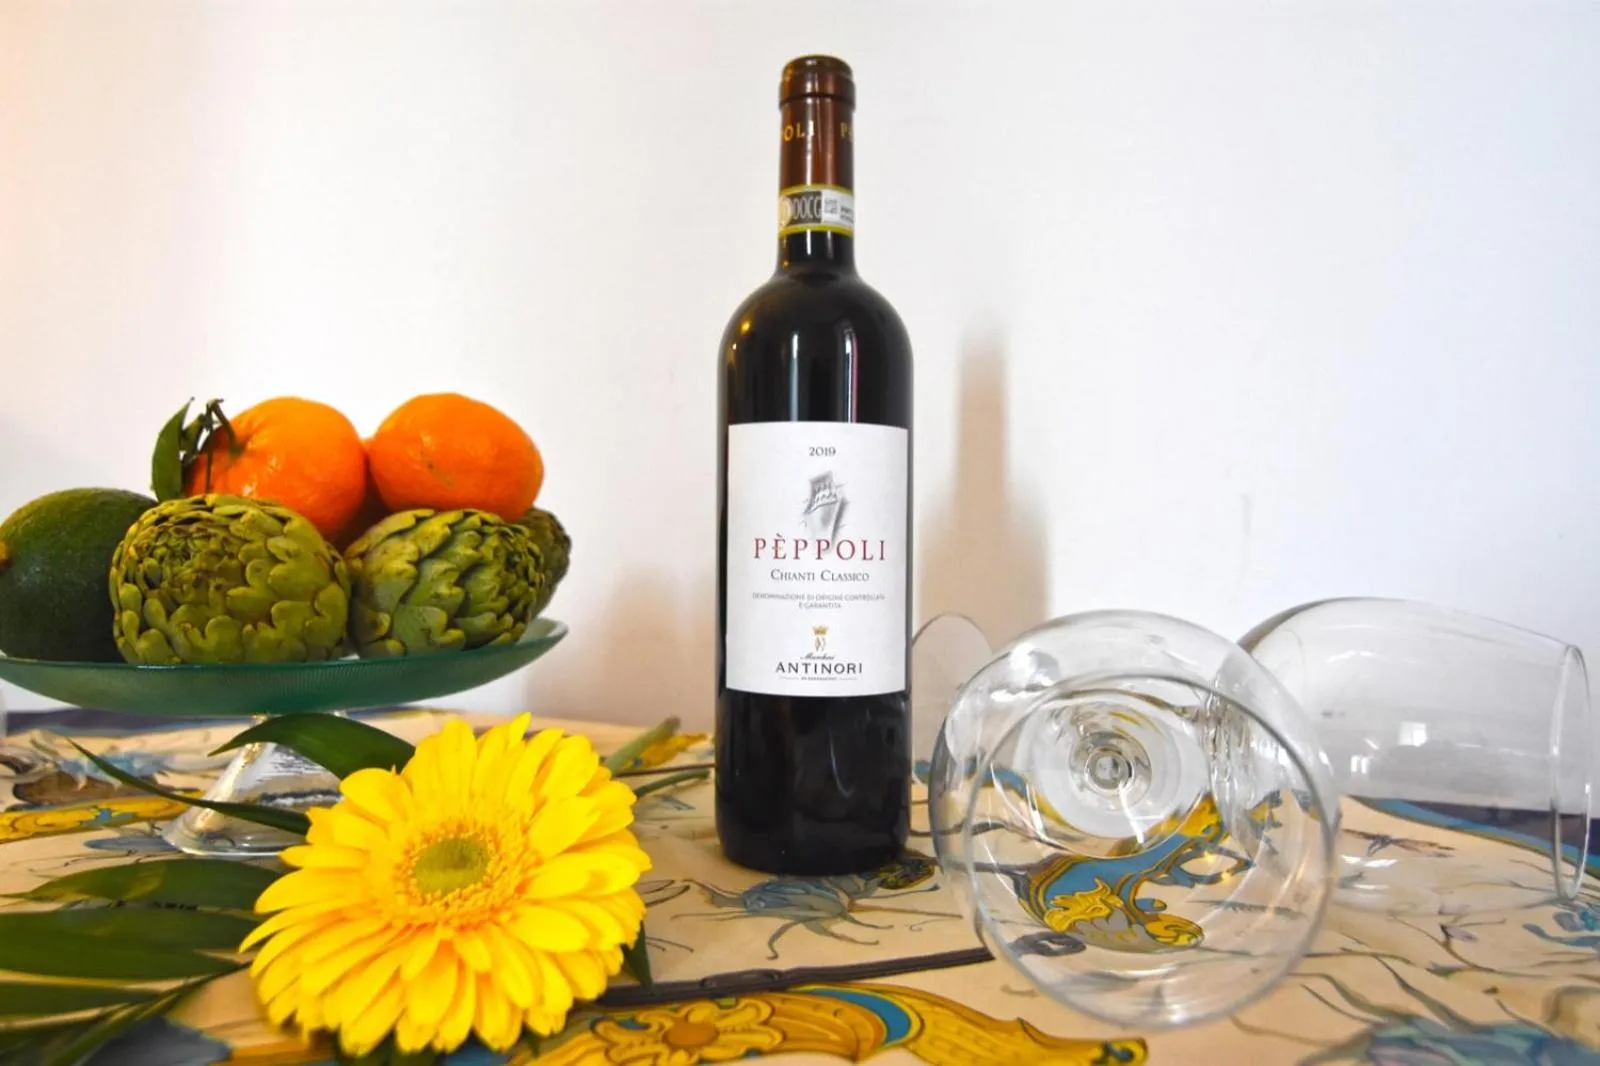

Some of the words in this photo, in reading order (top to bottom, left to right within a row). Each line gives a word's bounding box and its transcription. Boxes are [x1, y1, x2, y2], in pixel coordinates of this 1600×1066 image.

[808, 446, 837, 457] 2019
[753, 533, 887, 561] PÈPPOLI
[775, 661, 863, 675] ANTINORI
